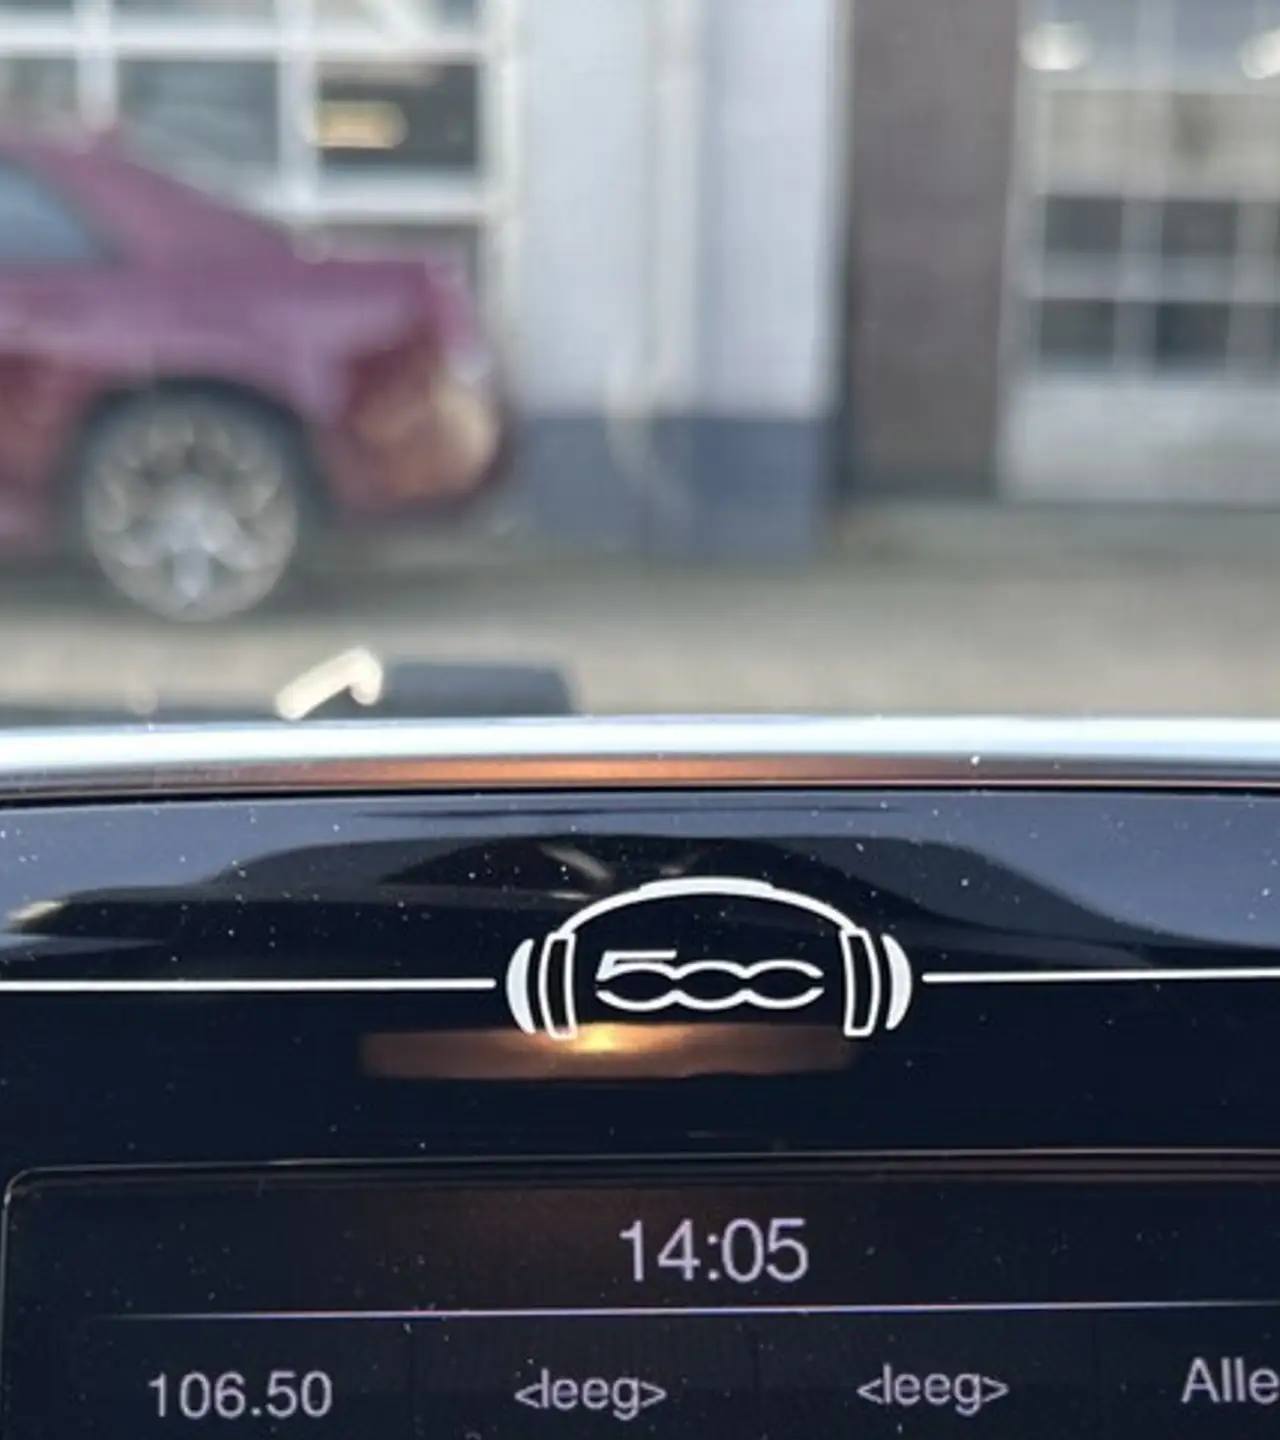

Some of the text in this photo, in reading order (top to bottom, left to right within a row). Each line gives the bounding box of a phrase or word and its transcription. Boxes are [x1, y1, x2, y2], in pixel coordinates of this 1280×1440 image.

[596, 950, 824, 1011] 500
[620, 1218, 809, 1283] 14:05
[147, 1370, 333, 1419] 106.50
[515, 1368, 667, 1421] <leeg>
[856, 1364, 1010, 1417] <leeg>
[1181, 1356, 1280, 1404] Alle
